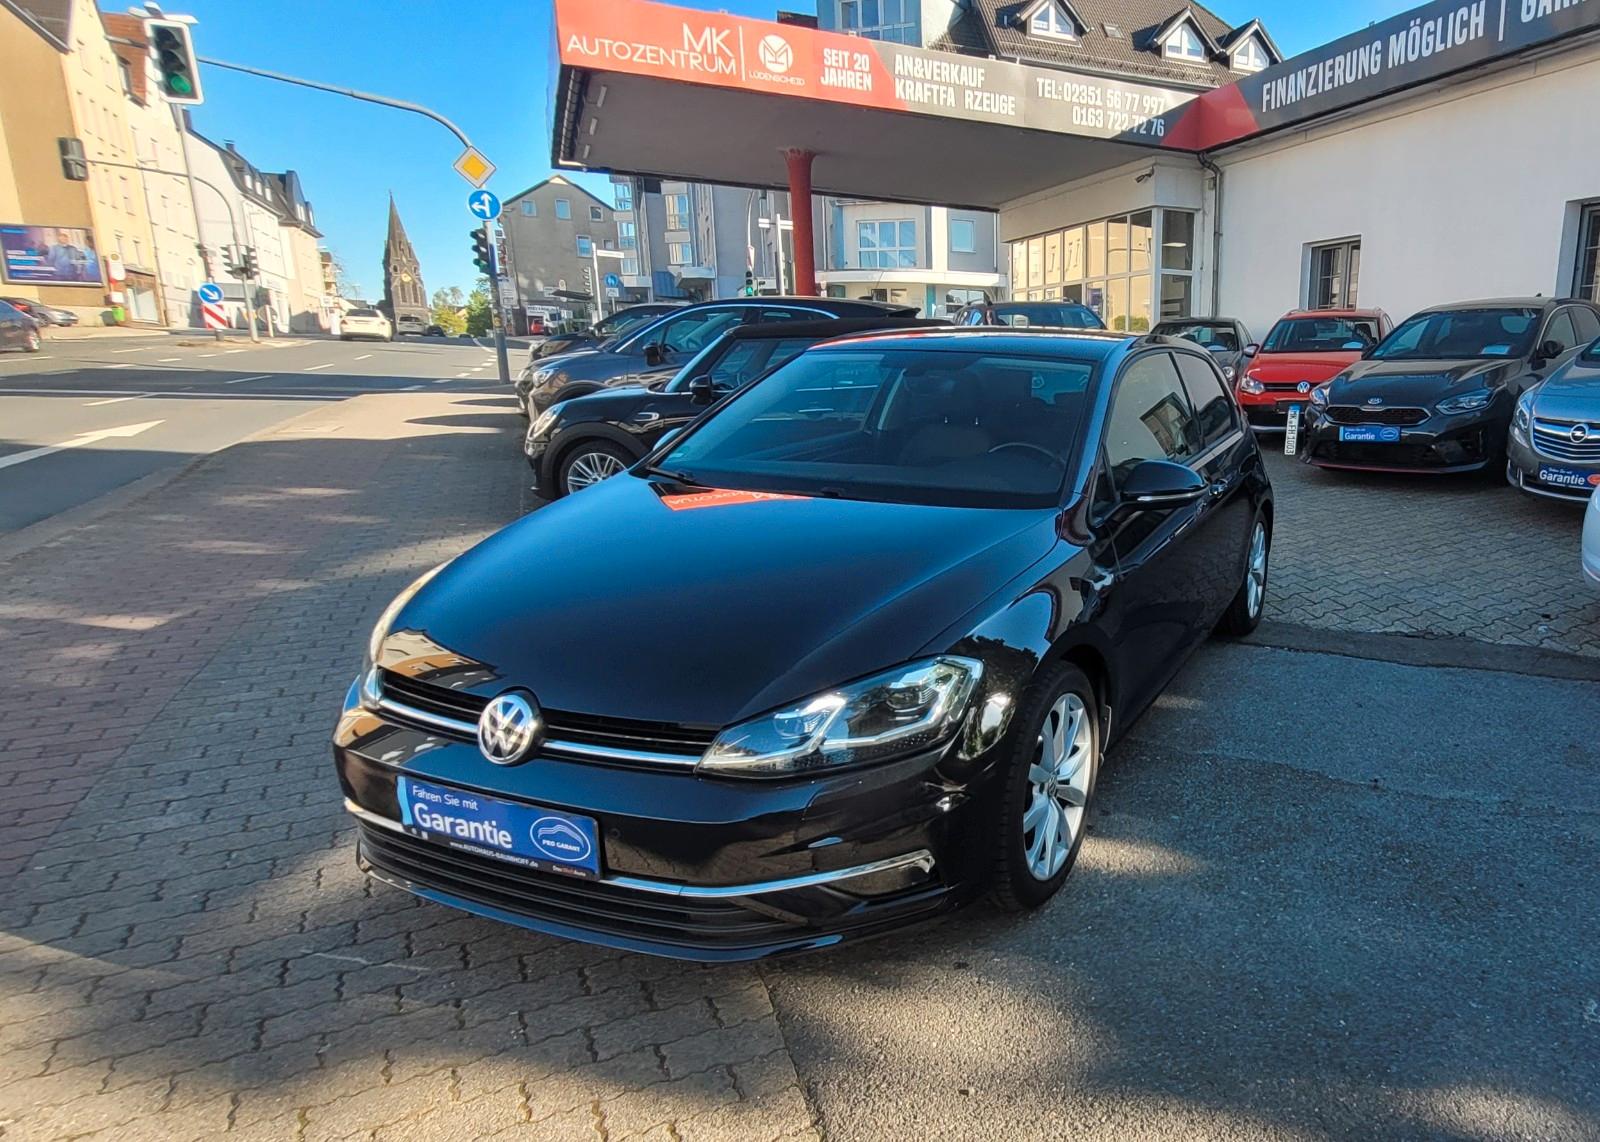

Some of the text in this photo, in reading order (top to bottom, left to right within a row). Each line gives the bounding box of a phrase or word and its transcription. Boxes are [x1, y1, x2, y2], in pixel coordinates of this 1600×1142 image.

[683, 23, 733, 57] MK
[567, 34, 737, 76] AUTOZENTRUM
[823, 47, 870, 71] SEIT 20
[1262, 0, 1486, 113] FINANZIERUNG MÖGLICH
[820, 67, 872, 92] JAHREN
[894, 54, 985, 89] AN&VERKAUF
[1106, 88, 1121, 109] 56
[1125, 92, 1140, 113] 77
[1142, 95, 1165, 114] 997
[1072, 106, 1165, 137] 0163 722 72 76
[1345, 432, 1376, 440] Garantie
[1540, 469, 1586, 485] Garantie
[412, 785, 479, 811] Fahren Sie mit
[413, 802, 513, 849] Garantie
